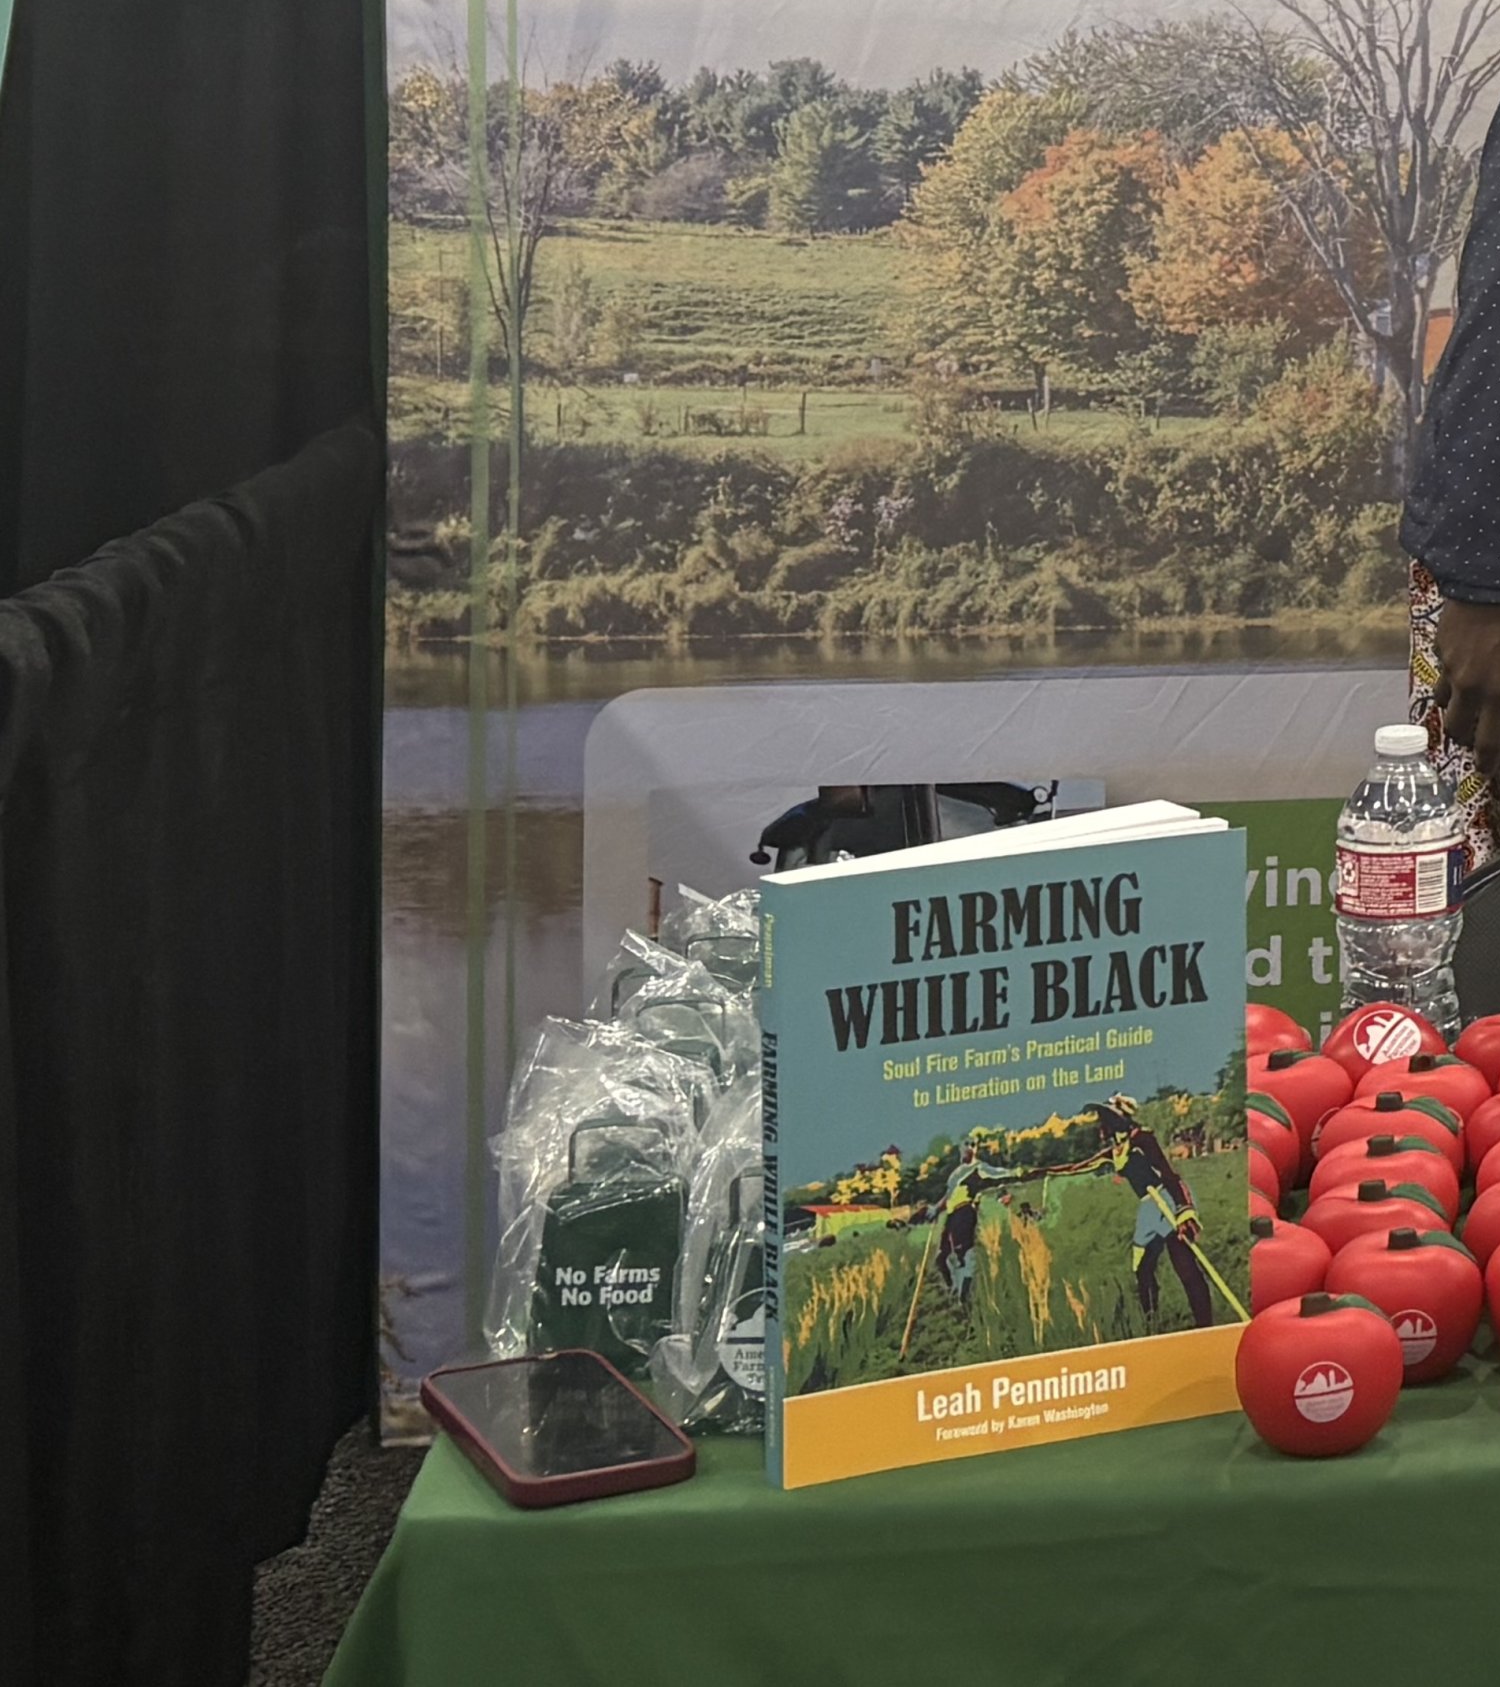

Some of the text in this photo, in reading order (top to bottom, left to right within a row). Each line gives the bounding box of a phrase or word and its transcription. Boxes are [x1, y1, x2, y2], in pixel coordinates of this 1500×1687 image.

[891, 872, 1143, 965] FARMING
[825, 941, 1208, 1052] WHILE BLACK
[883, 1025, 1153, 1080] Soul Fire Farm's Practical Guide
[913, 1059, 1125, 1108] to Liberation on the Land
[761, 1031, 778, 1323] FARMING WHILE BLACK
[555, 1265, 661, 1286] No Farms
[561, 1284, 654, 1306] No Food
[917, 1365, 1126, 1422] Leah Penniman
[936, 1402, 1109, 1441] Foreword by Karen Washington
